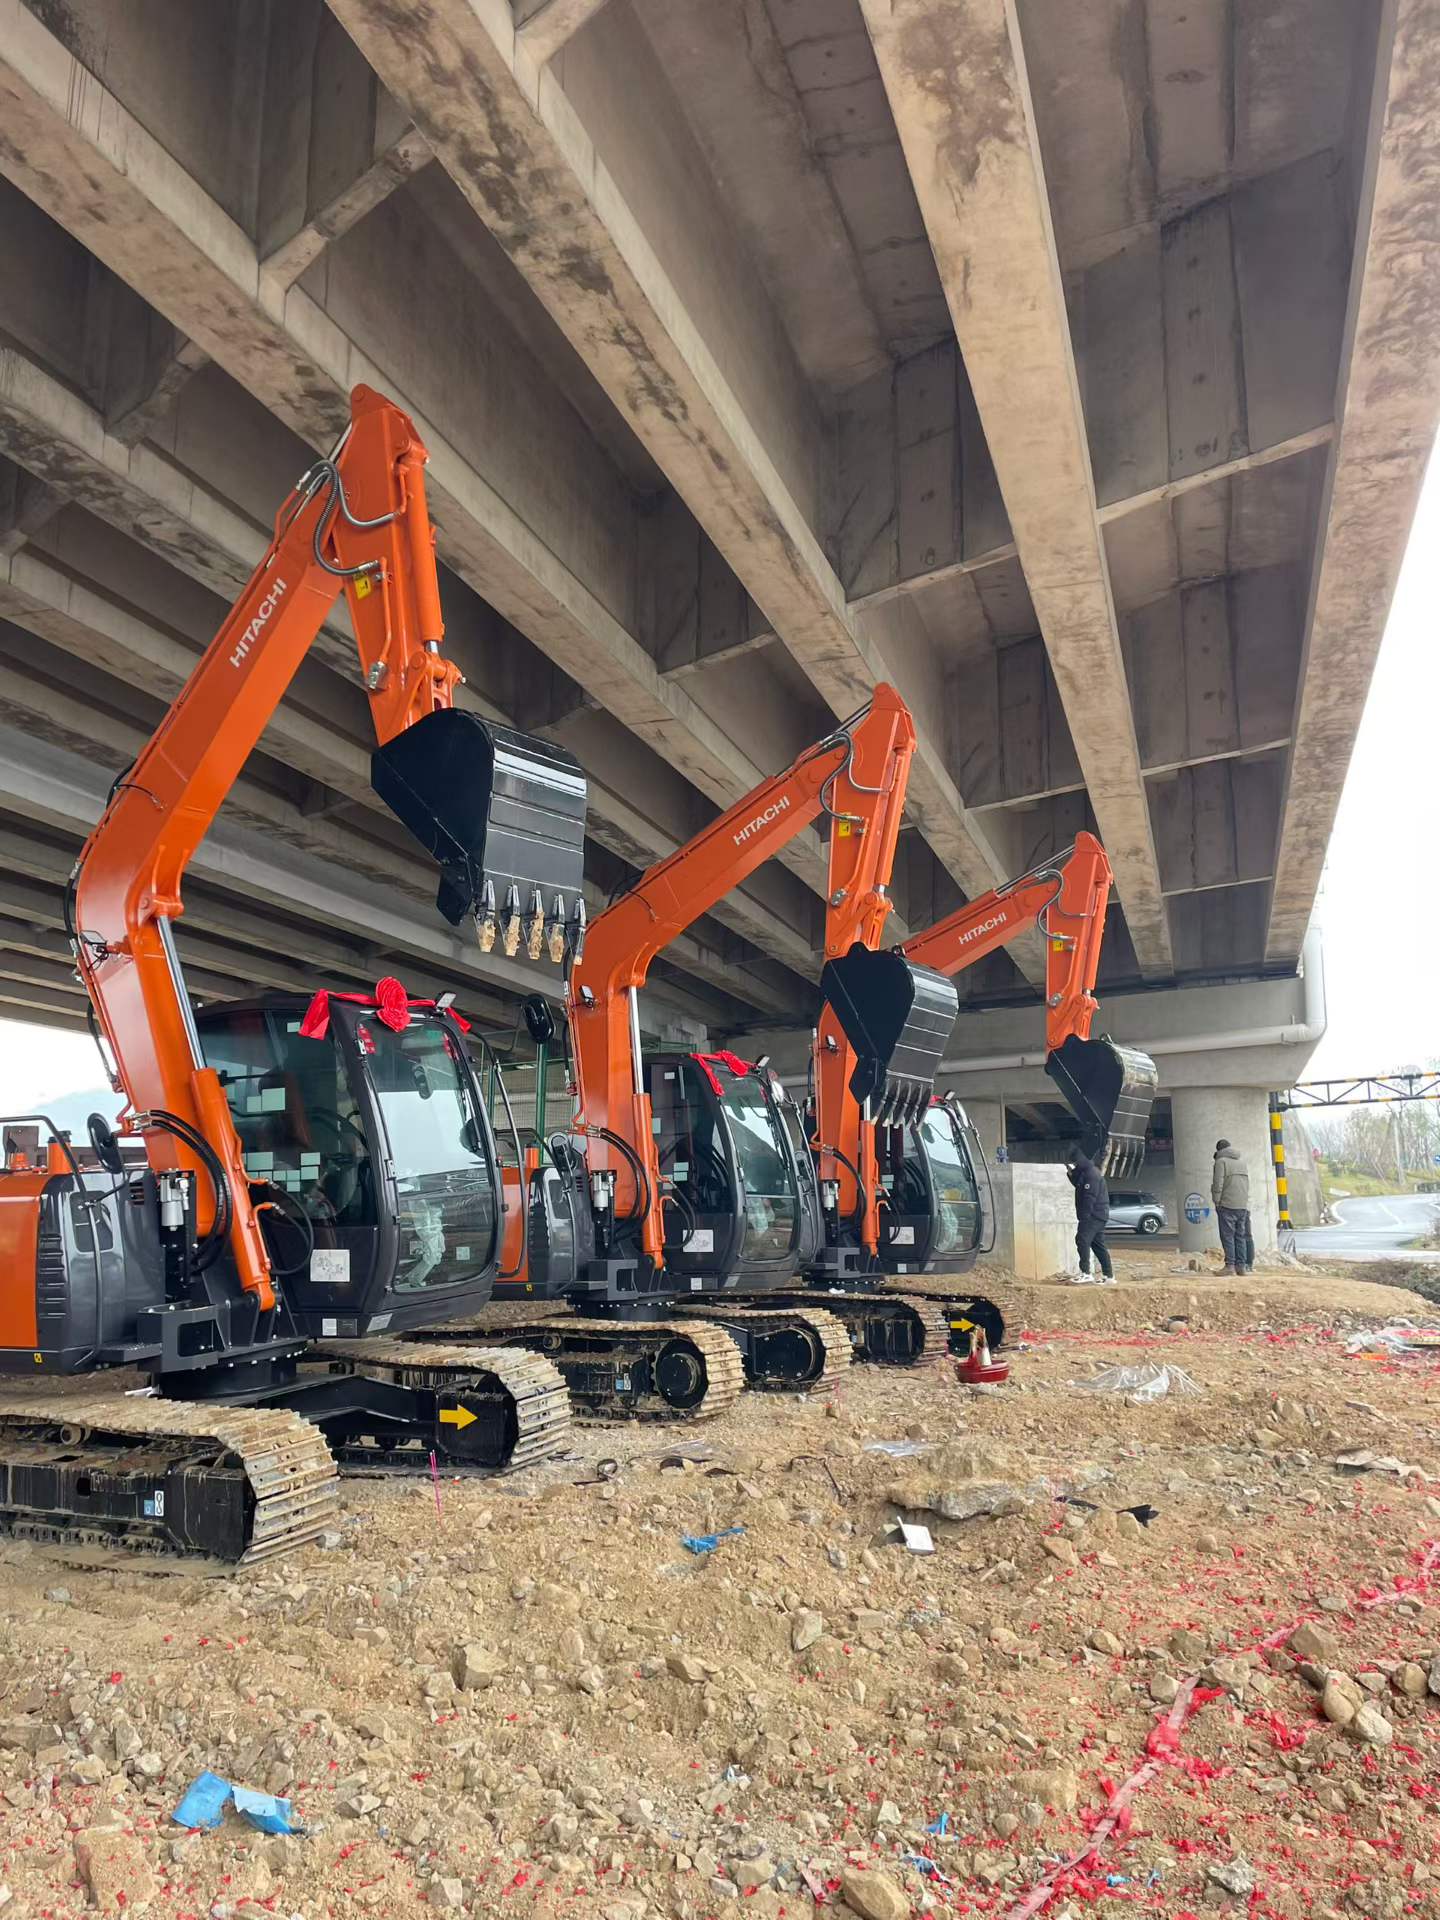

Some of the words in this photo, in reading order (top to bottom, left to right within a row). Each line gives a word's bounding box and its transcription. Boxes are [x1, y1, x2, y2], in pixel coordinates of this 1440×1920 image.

[229, 577, 288, 668] HITACHI
[733, 795, 790, 846] HITACHI
[958, 911, 1007, 945] HITACHI
